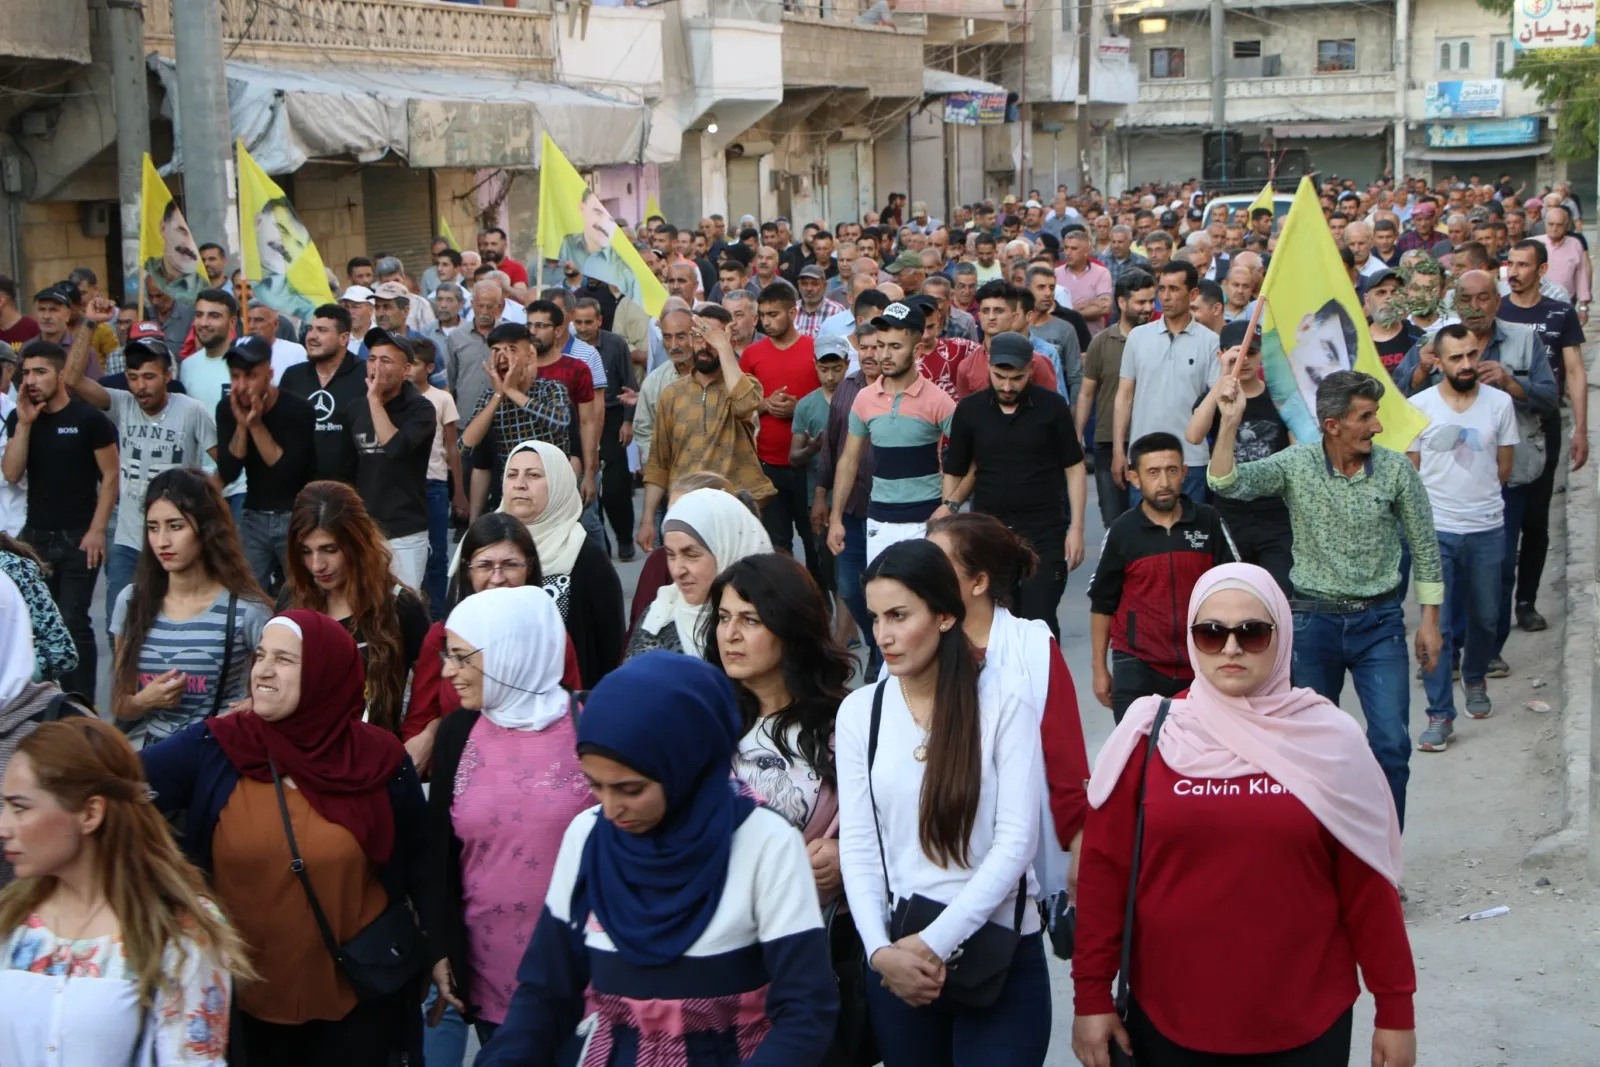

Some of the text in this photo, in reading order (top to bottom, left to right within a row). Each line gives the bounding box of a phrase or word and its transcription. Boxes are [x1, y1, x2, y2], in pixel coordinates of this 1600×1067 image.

[1519, 20, 1591, 43] روليان
[1173, 777, 1292, 796] Calvin Klei
